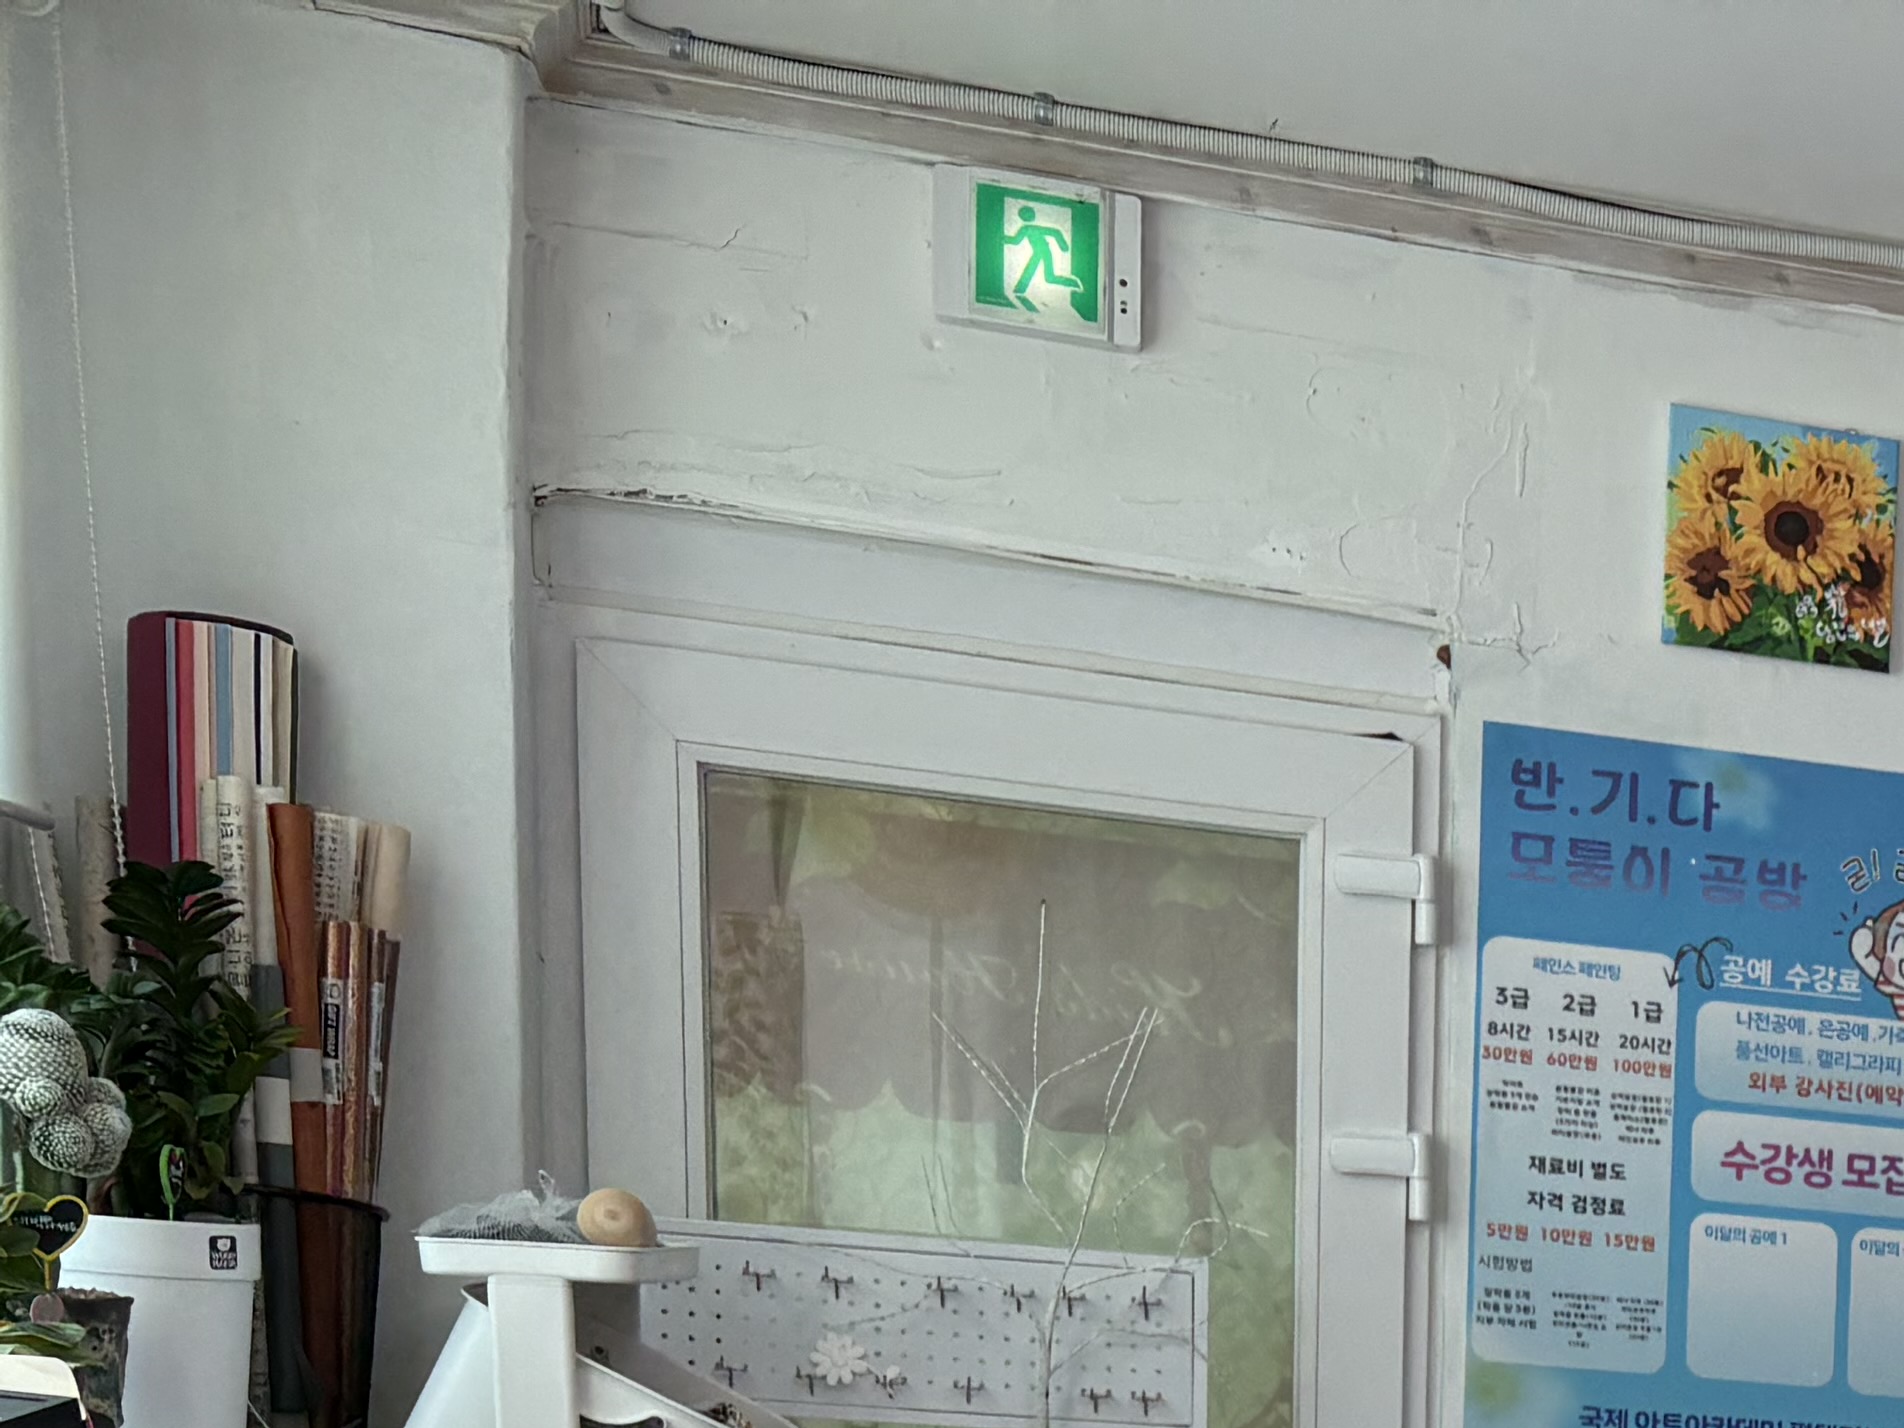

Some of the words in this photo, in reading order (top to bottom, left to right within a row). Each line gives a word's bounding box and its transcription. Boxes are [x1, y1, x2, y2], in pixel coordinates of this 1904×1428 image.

[1511, 757, 1721, 833] 반.기.다
[1507, 831, 1671, 898] 모퉁이
[1699, 852, 1808, 912] 공방
[1720, 955, 1773, 987] 공예
[1785, 963, 1862, 995] 수강료
[1495, 986, 1531, 1010] 3급
[1562, 993, 1598, 1018] 2급
[1631, 1000, 1664, 1025] 1급
[1487, 1021, 1532, 1042] 8시간
[1548, 1027, 1600, 1049] 15시간
[1619, 1034, 1672, 1056] 20시간
[1547, 1053, 1599, 1073] 60만원
[1613, 1058, 1673, 1080] 100만원
[1748, 1072, 1787, 1094] 외부
[1528, 1155, 1584, 1178] 재료비
[1591, 1161, 1627, 1182] 별도
[1720, 1140, 1834, 1190] 수강생
[1527, 1190, 1564, 1212] 자격
[1572, 1194, 1627, 1216] 검정료
[1487, 1222, 1529, 1242] 5만원
[1541, 1227, 1593, 1248] 10만원
[1604, 1232, 1656, 1253] 15만원
[1479, 1254, 1533, 1274] 시험방법
